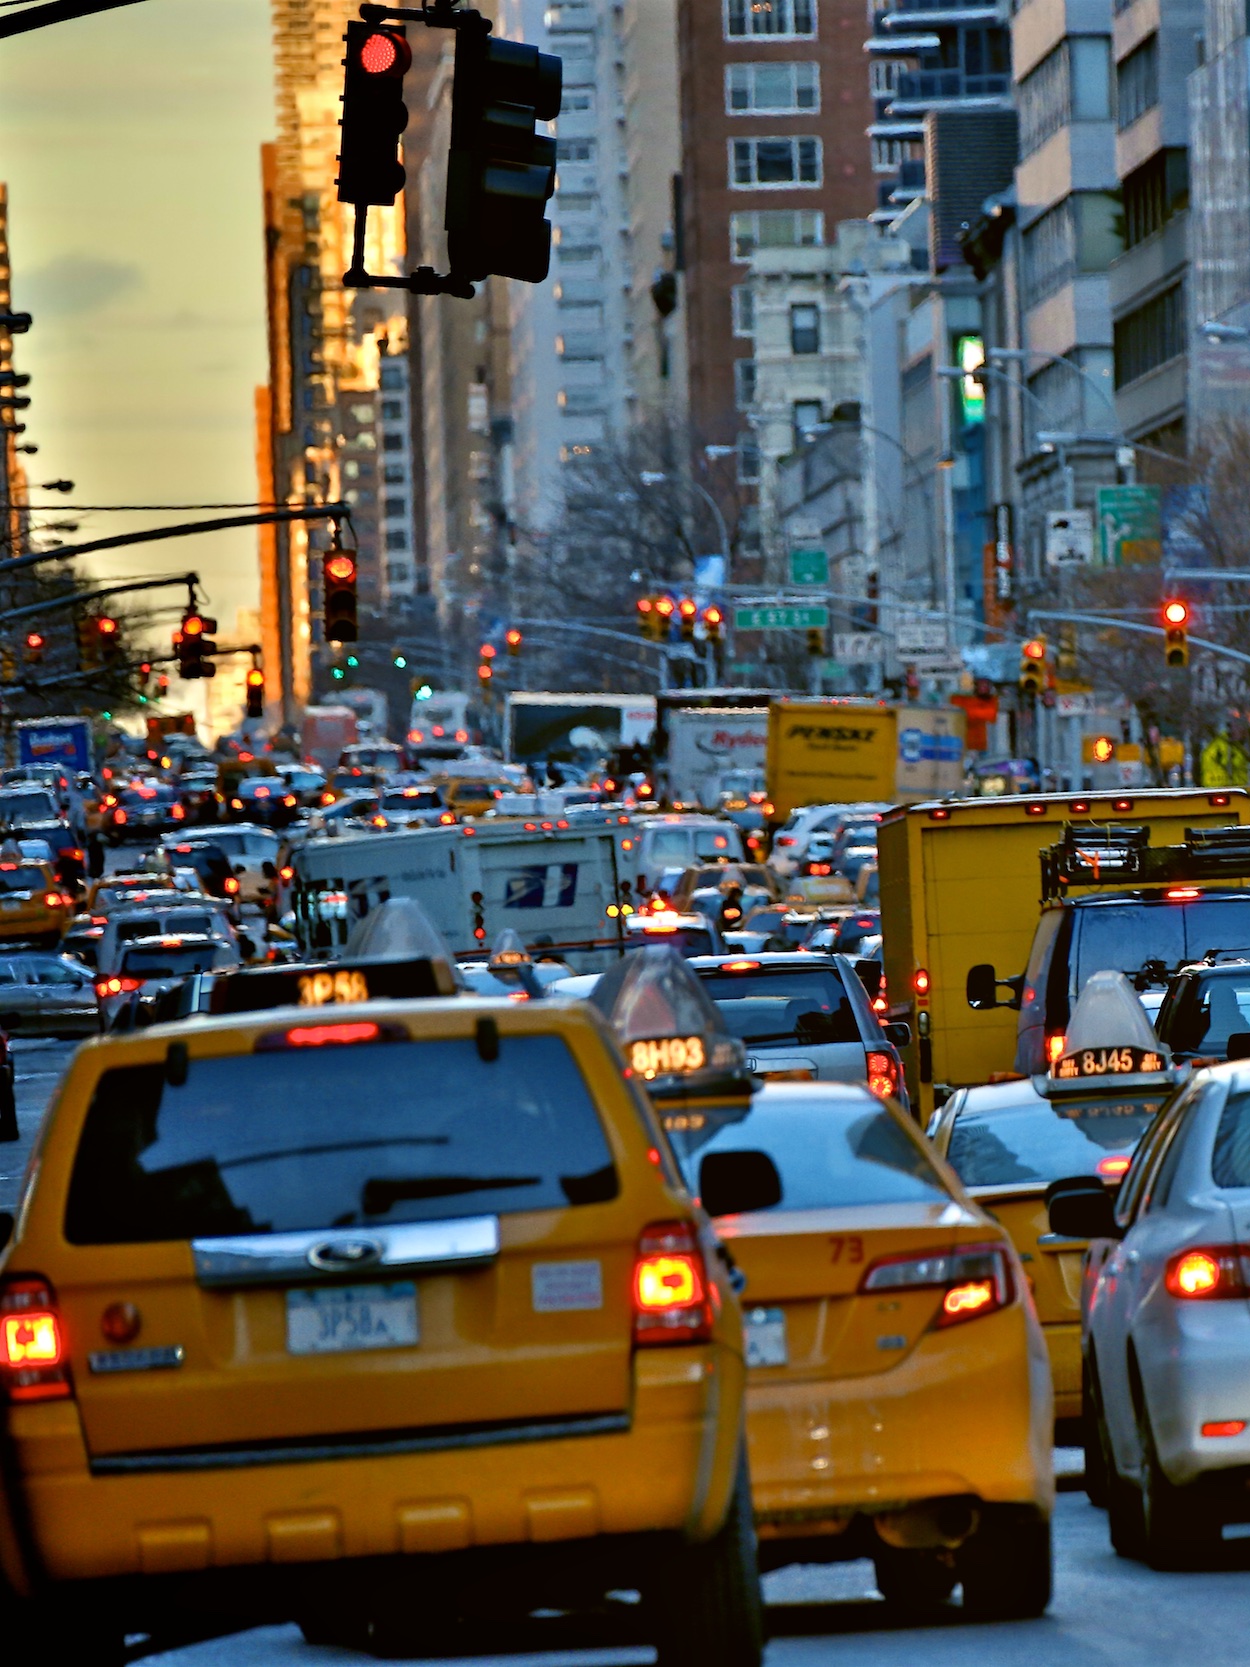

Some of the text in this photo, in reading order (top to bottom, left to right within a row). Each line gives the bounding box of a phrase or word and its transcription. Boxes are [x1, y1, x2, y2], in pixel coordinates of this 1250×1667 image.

[631, 1037, 705, 1073] 8H93
[1082, 1048, 1134, 1075] 8J45
[828, 1235, 865, 1265] 73
